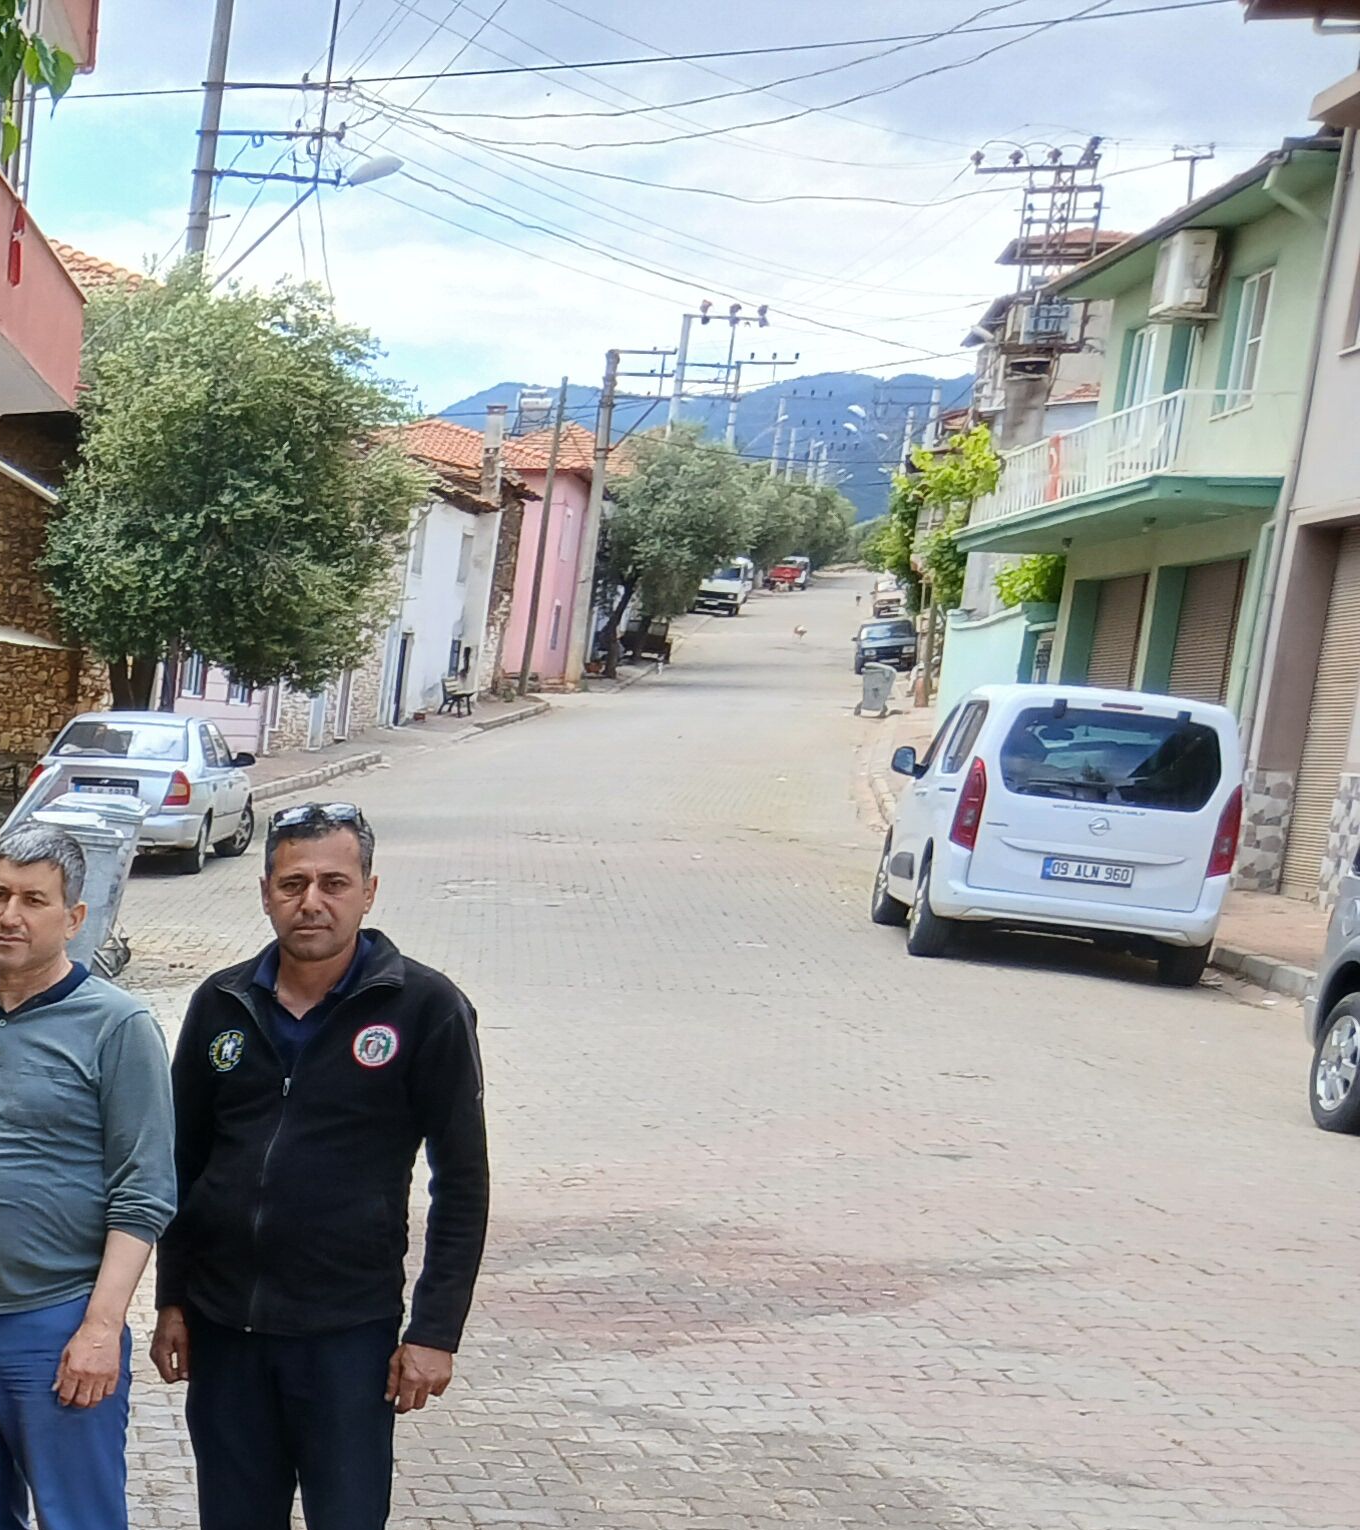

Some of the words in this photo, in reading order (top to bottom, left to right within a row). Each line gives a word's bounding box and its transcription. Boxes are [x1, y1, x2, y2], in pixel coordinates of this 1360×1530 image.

[1051, 861, 1069, 876] 09
[1074, 864, 1100, 878] ALN
[1104, 867, 1130, 882] 960
